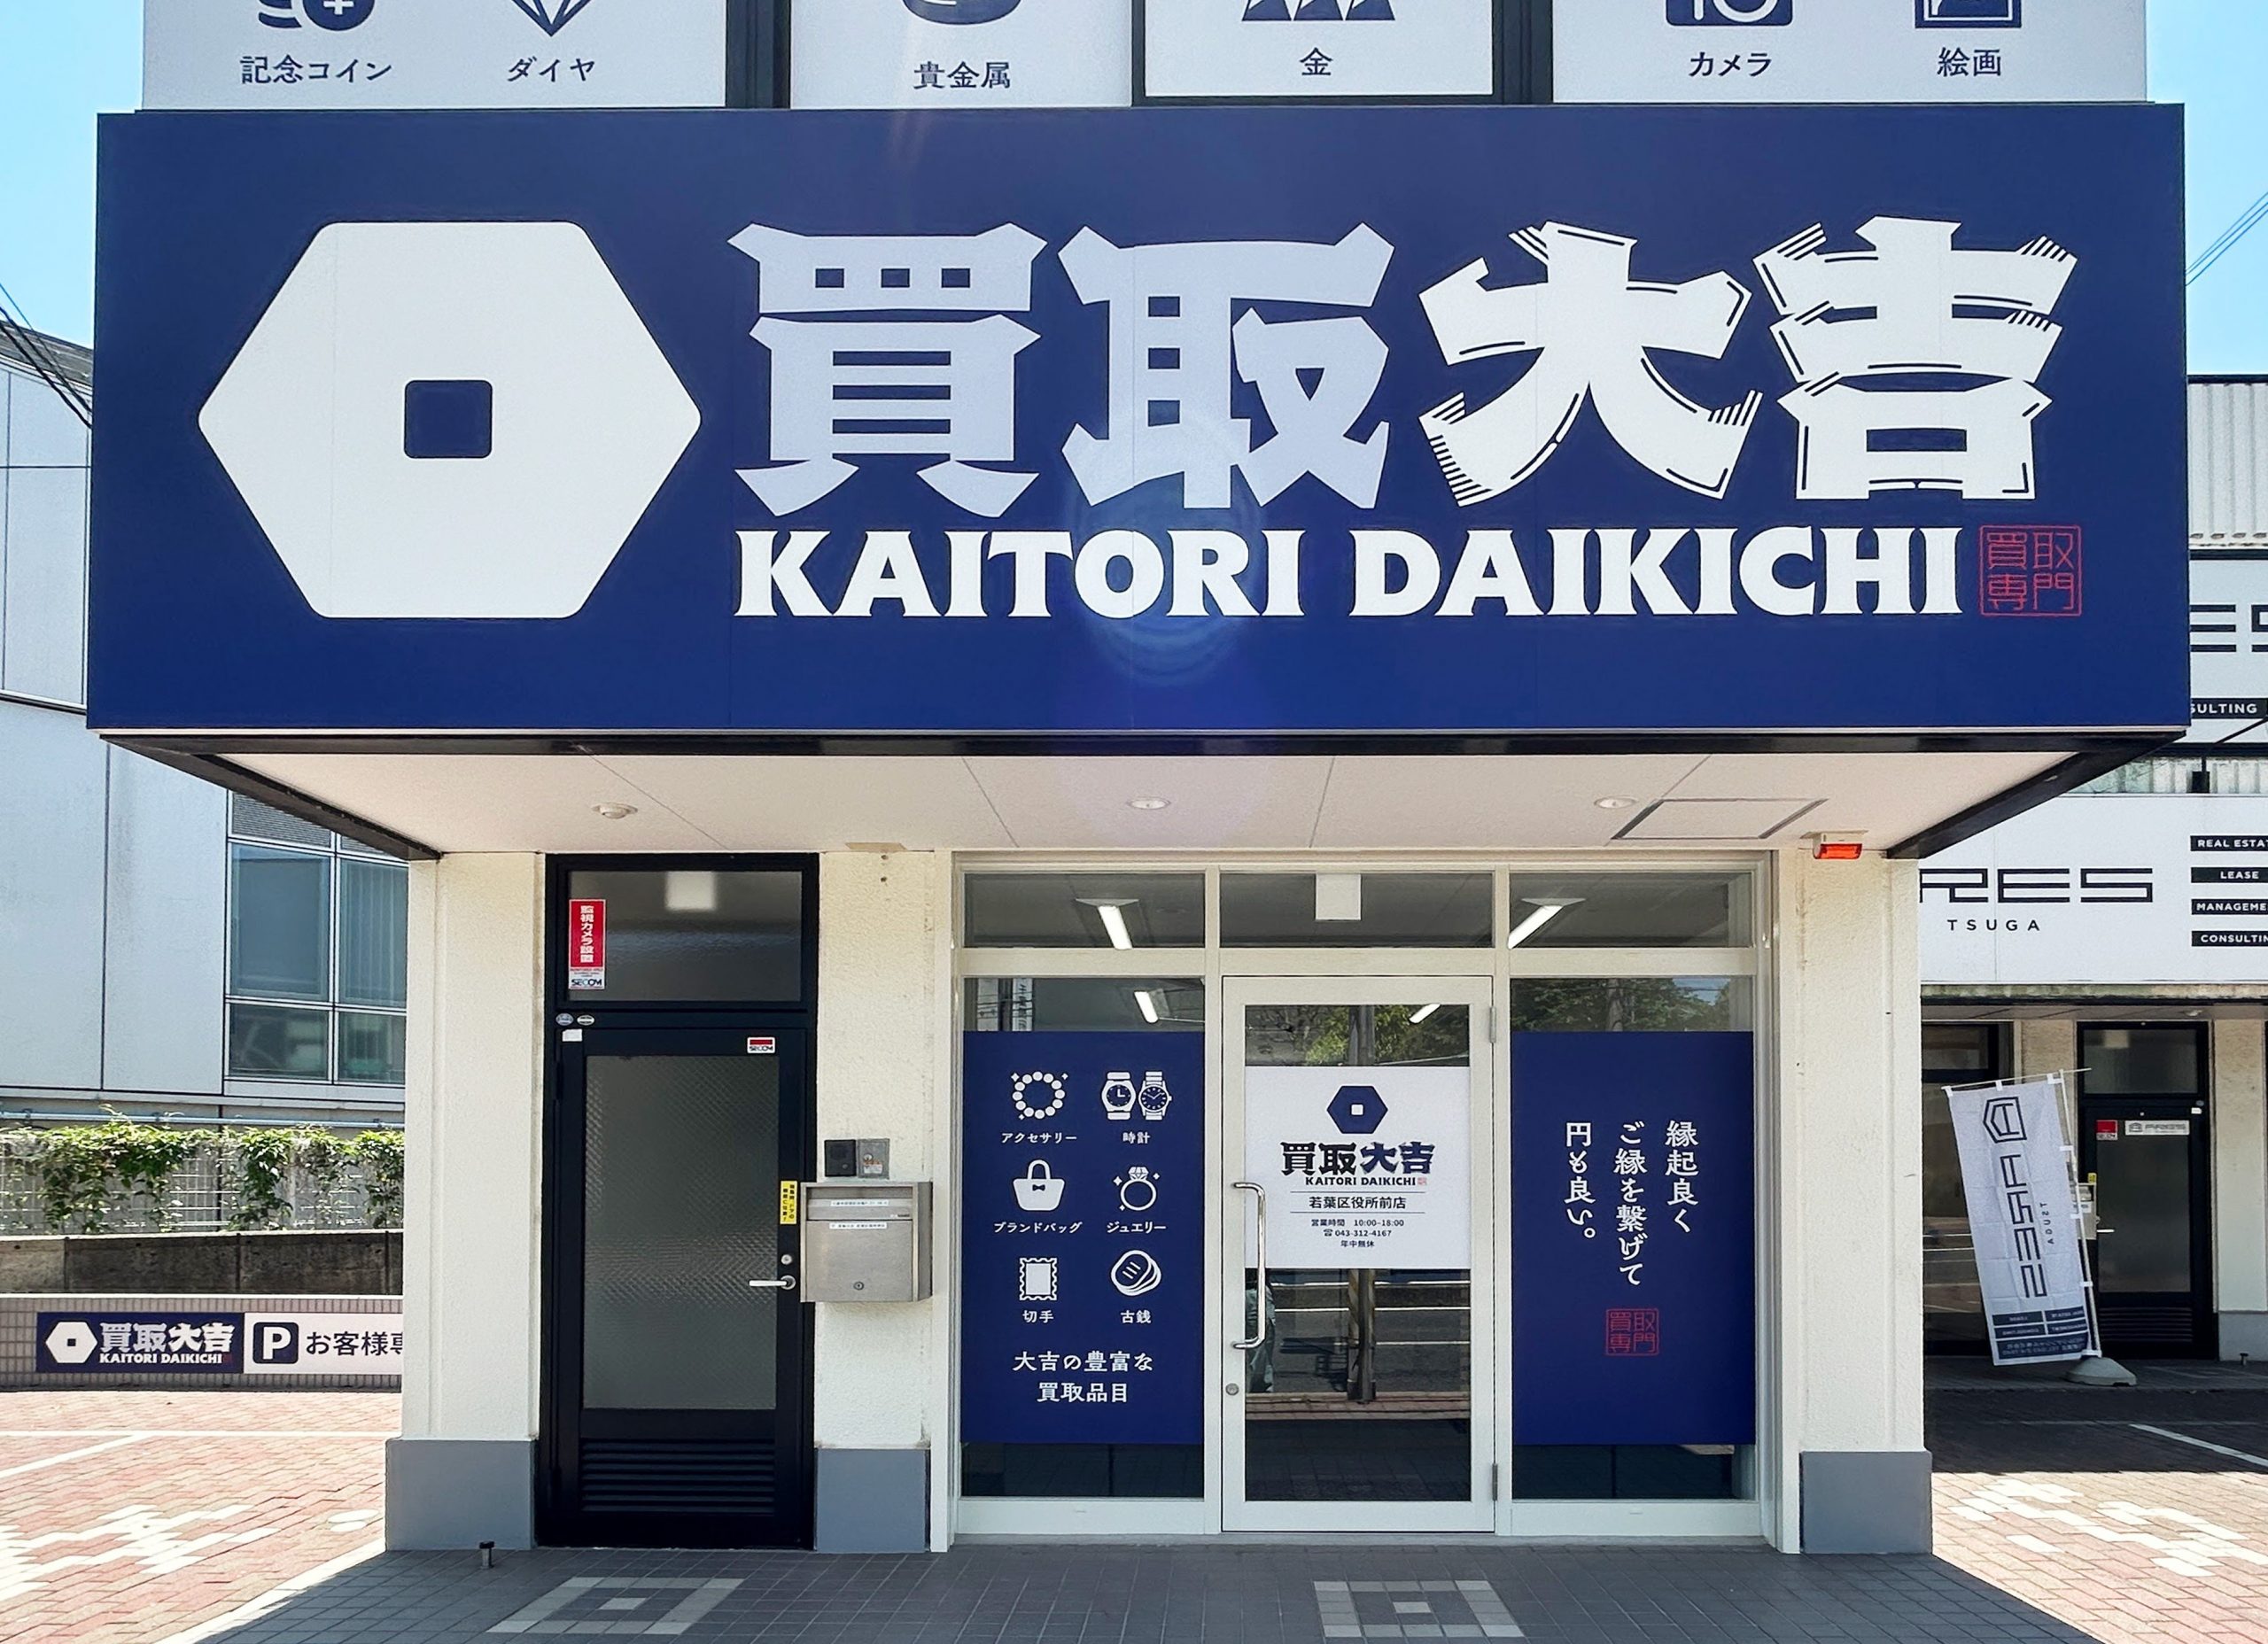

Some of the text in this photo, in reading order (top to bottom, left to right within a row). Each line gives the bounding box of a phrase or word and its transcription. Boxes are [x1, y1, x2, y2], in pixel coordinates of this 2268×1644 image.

[239, 54, 392, 84] 記念コイン
[507, 56, 596, 83] ダイヤ
[1299, 47, 1333, 77] 金
[1688, 51, 1773, 78] カメラ
[1937, 46, 2002, 78] 絵画
[913, 60, 1011, 89] 貴金属
[727, 215, 2078, 517] 買取大吉
[734, 525, 1963, 619] KAITORI DAIKICHI
[2197, 839, 2268, 848] REAL ESTA
[2220, 871, 2260, 880] LEASE
[1946, 919, 2041, 932] TSUGA
[1001, 1132, 1078, 1144] アクセサリー
[1122, 1131, 1152, 1144] 時計
[1280, 1142, 1435, 1175] 買取大吉
[1305, 1176, 1357, 1186] KAITORI
[1361, 1176, 1416, 1186] DAIKICHI
[1564, 1122, 1596, 1238] 円も良い。
[1665, 1120, 1699, 1233] 縁起良く
[1309, 1196, 1407, 1209] 若葉区役所前店
[1613, 1121, 1649, 1285] ご縁を繋げて
[994, 1221, 1083, 1234] ブランドバッグ
[1107, 1221, 1167, 1234] ジュエリー
[1022, 1309, 1054, 1323] 切手
[1120, 1309, 1152, 1324] 古銭
[100, 1322, 236, 1353] 買取大吉
[262, 1326, 291, 1360] P
[99, 1353, 158, 1364] KAITORI
[160, 1353, 222, 1364] DAIKICHI
[1012, 1350, 1153, 1372] 大吉の豊富な
[1037, 1382, 1128, 1403] 買取品目
